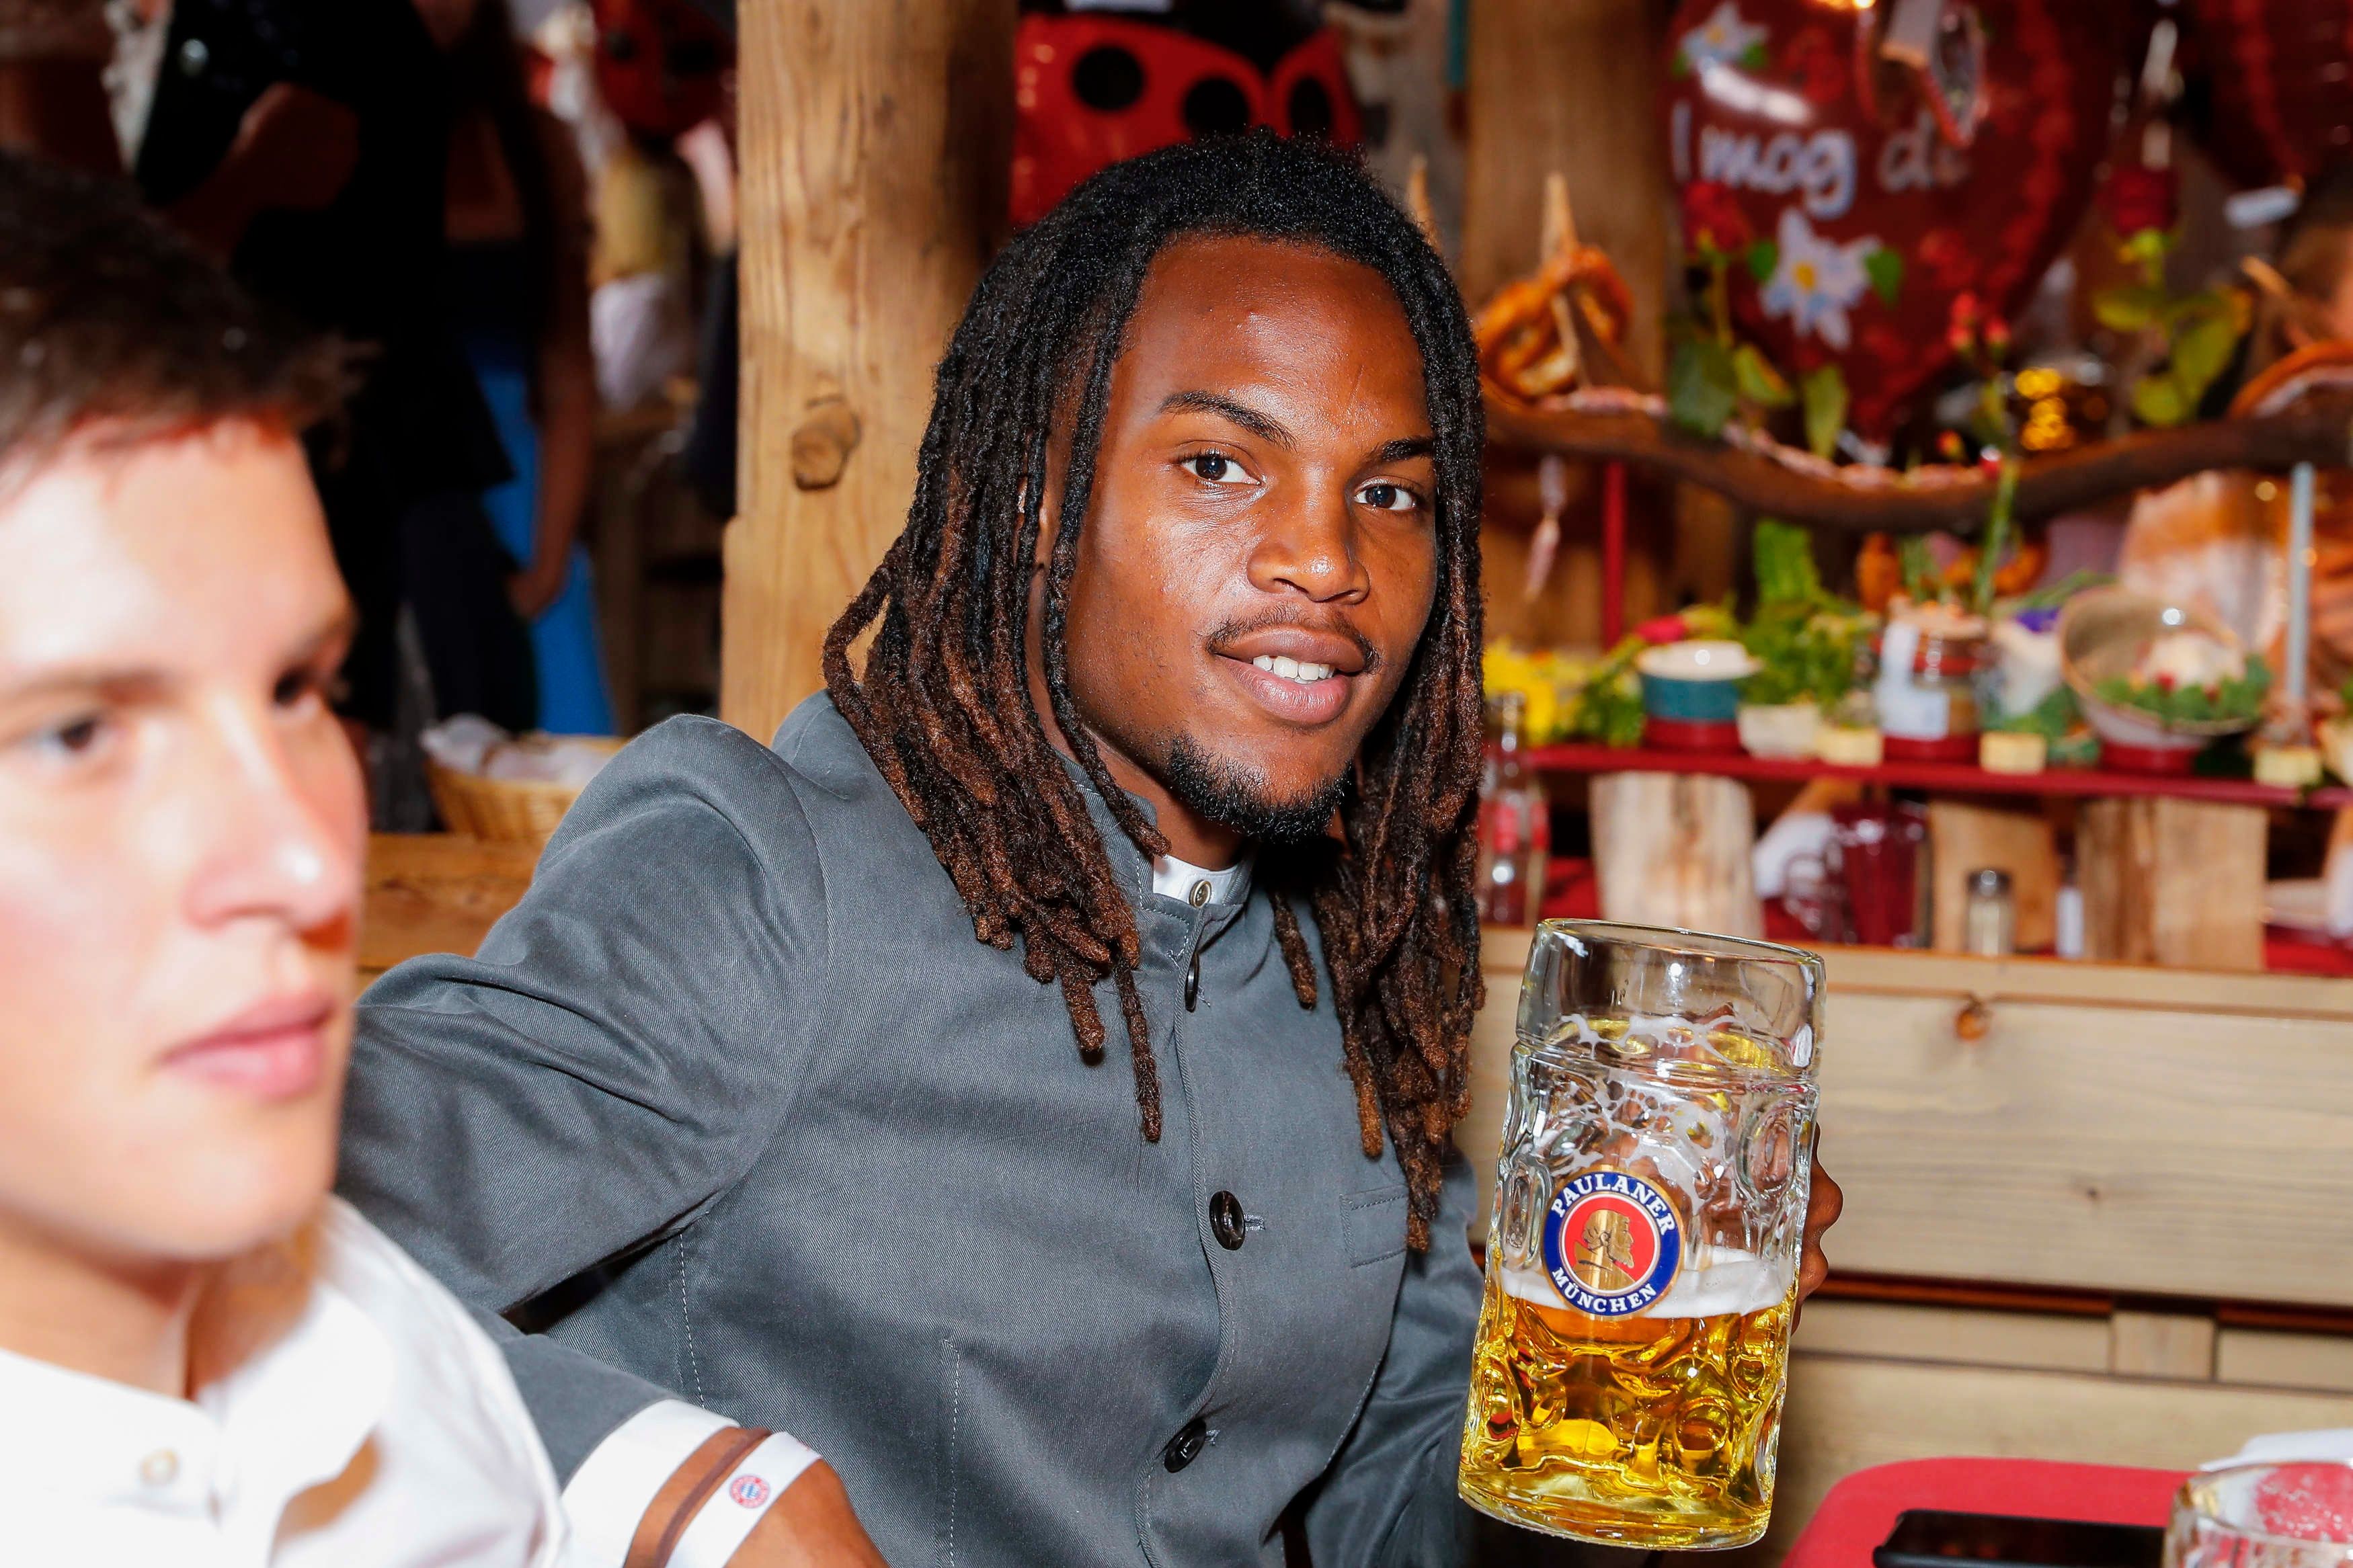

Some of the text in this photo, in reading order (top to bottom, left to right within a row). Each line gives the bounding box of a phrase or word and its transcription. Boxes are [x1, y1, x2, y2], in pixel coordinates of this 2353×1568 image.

[1700, 125, 1857, 221] mog
[1550, 1173, 1676, 1236] PAULANER
[1551, 1266, 1658, 1313] MÜNCHEN
